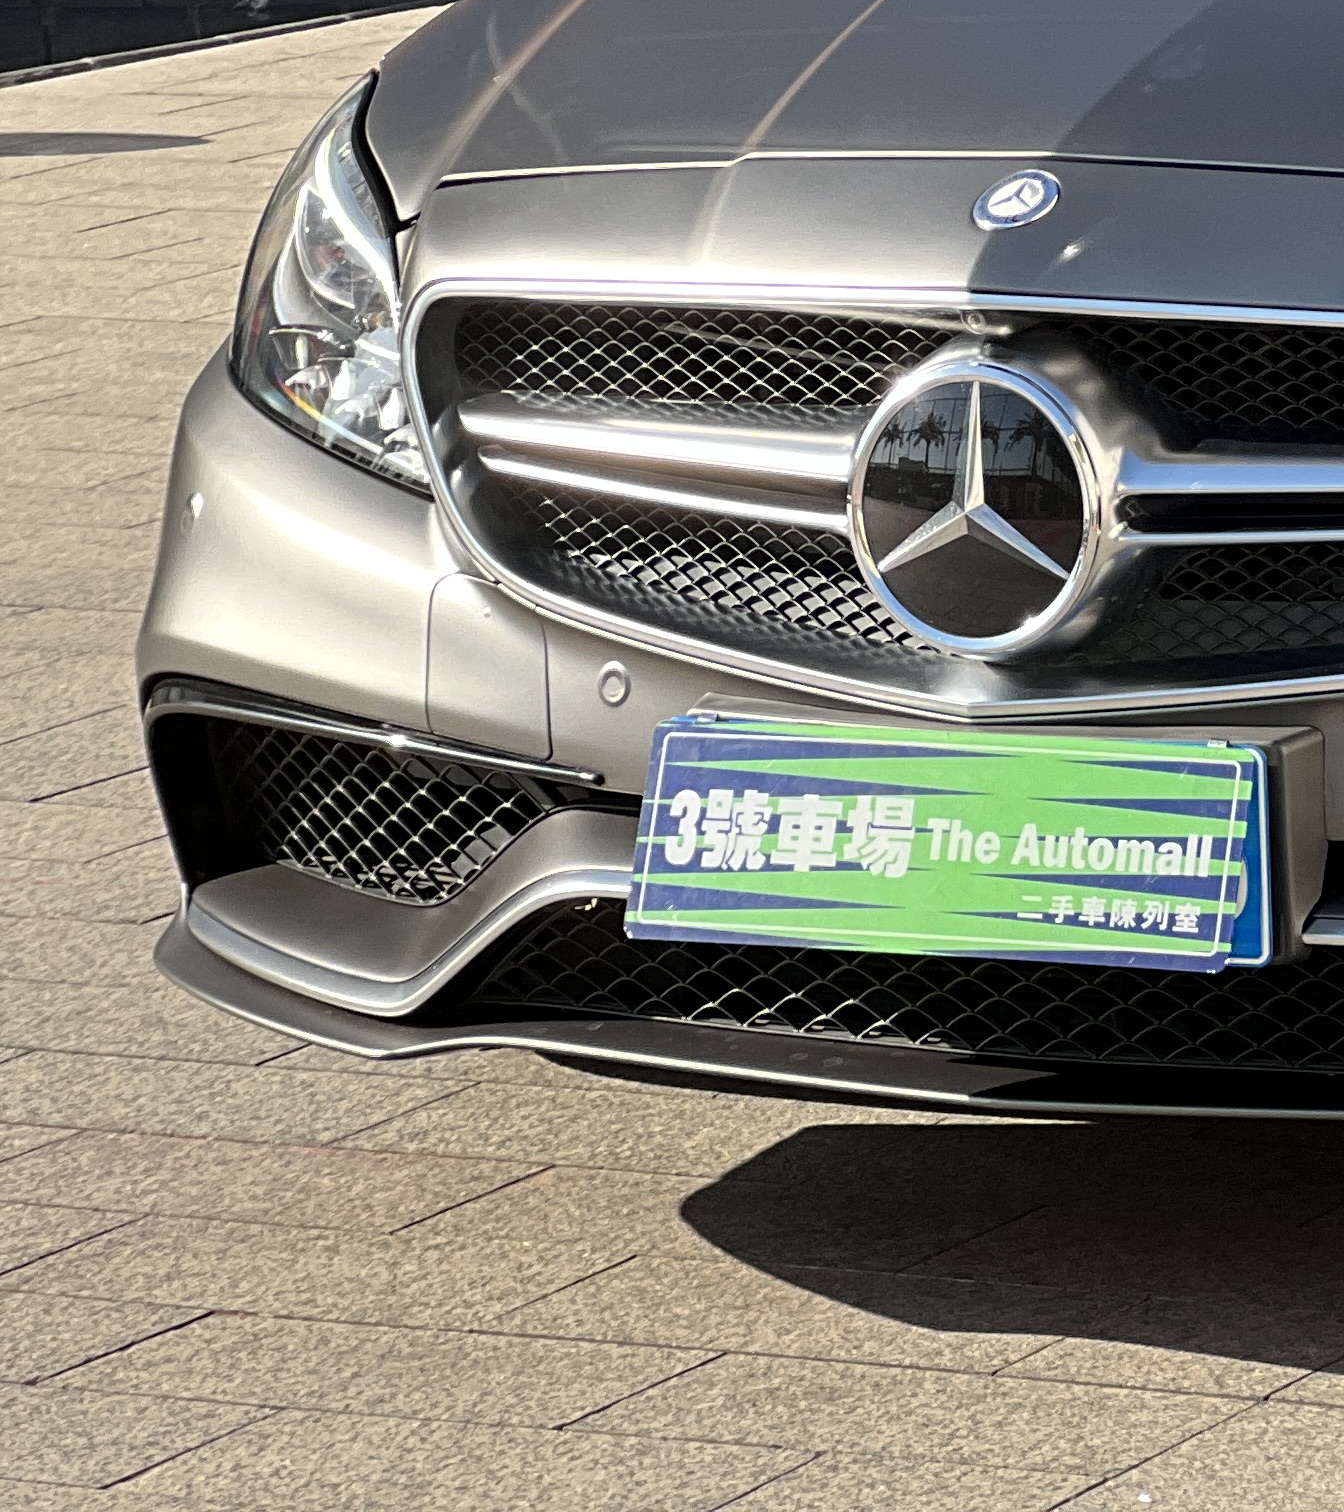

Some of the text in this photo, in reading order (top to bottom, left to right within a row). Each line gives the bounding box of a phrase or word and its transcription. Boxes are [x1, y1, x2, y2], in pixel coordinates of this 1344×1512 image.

[664, 788, 1214, 878] 3號車場 The Automall
[1016, 894, 1202, 934] 二手車陳列室
